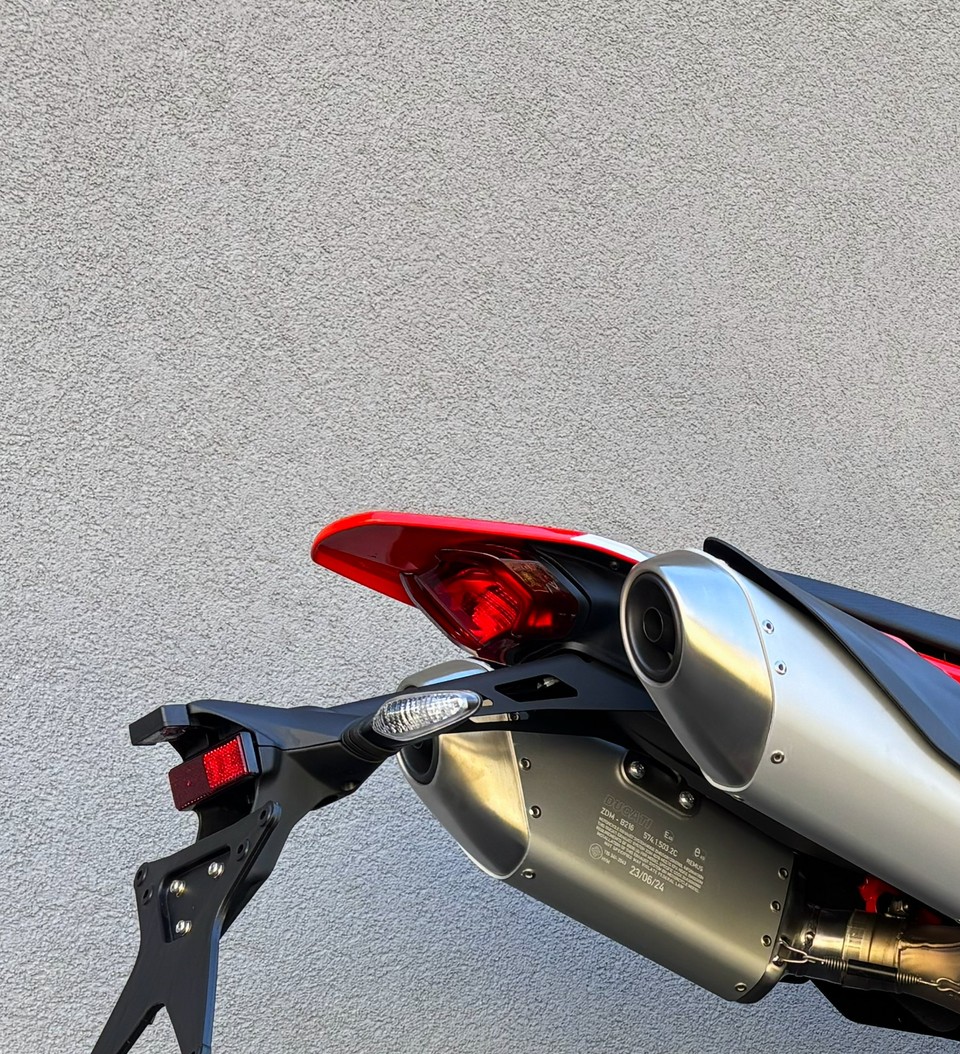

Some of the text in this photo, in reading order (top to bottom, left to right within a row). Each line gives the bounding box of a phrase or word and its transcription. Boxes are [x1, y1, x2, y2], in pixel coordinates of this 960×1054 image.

[600, 807, 615, 820] ZDM
[604, 794, 653, 830] DUCATI
[629, 866, 664, 892] 23/06/24
